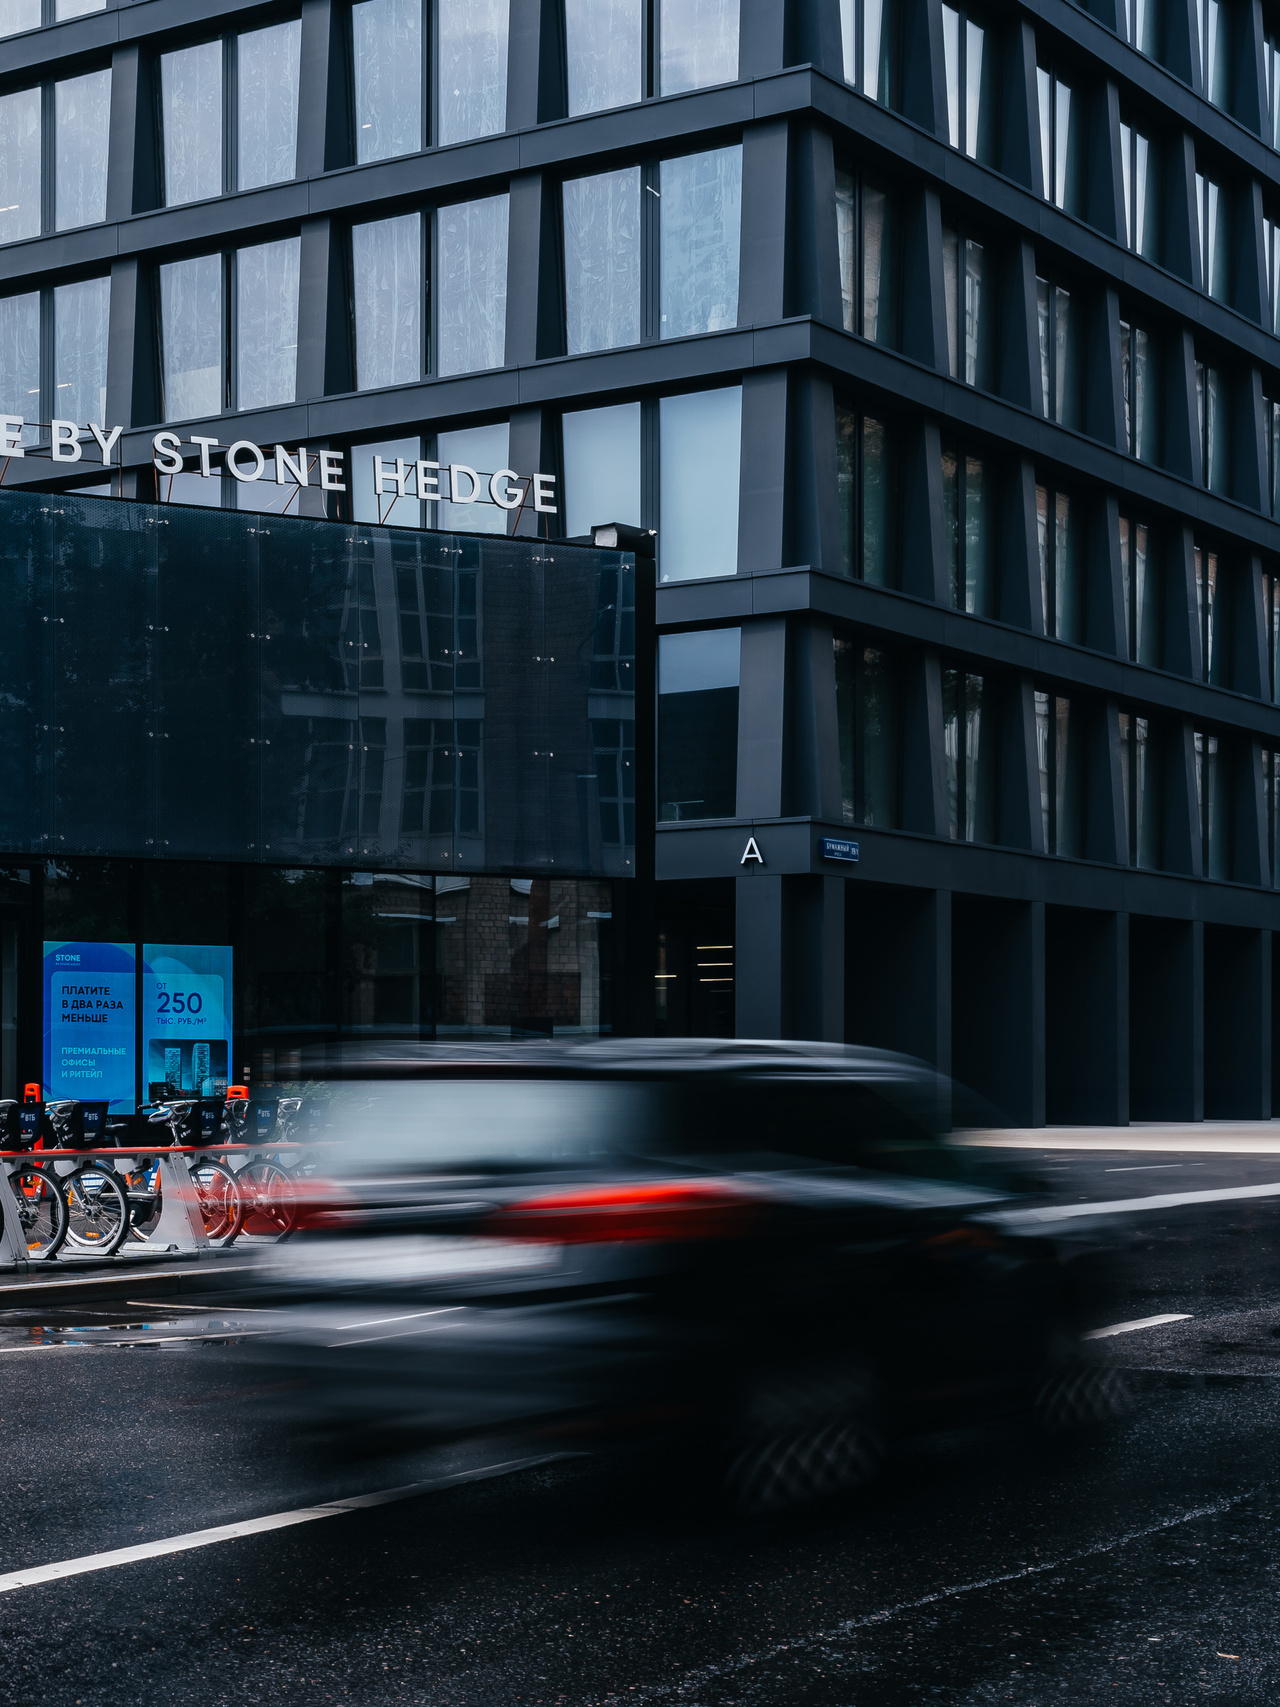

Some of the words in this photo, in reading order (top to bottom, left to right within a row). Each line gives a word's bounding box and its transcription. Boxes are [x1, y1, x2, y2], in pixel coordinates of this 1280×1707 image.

[50, 419, 123, 466] BY
[153, 432, 346, 492] STONE
[373, 455, 557, 514] HEDGE
[55, 954, 81, 962] STONE
[62, 986, 110, 996] ПЛАТИТЕ
[62, 1000, 69, 1009] В
[71, 1000, 94, 1011] ДВА
[96, 1000, 124, 1010] РАЗА
[157, 992, 203, 1014] 250
[62, 1013, 108, 1023] МЕНЬШЕ
[156, 1017, 176, 1025] ТЫС.
[61, 1047, 126, 1055] ПРЕМИАЛЬНЫЕ
[61, 1059, 96, 1067] ОФИСЫ
[70, 1069, 103, 1078] РИТЕЙЛ
[24, 1114, 36, 1122] ВТБ
[88, 1113, 99, 1121] ВТБ
